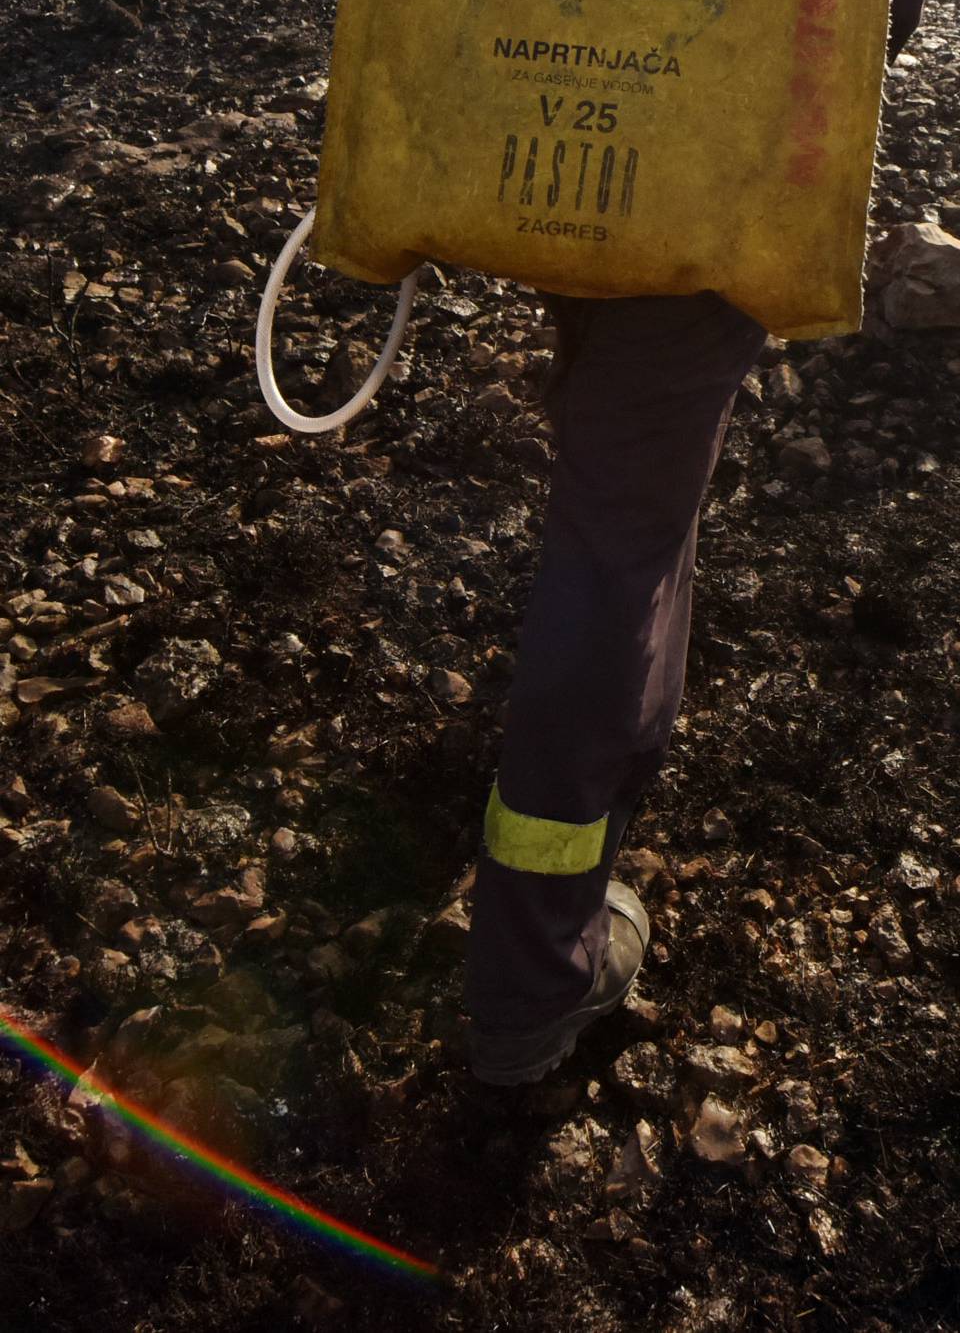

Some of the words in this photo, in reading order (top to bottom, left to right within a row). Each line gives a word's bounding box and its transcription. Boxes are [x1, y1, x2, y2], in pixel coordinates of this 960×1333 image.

[493, 37, 681, 77] NAPRTNJAČA
[511, 69, 530, 82] ZA
[602, 80, 654, 95] VODOM
[540, 95, 564, 126] V
[572, 100, 618, 133] 25
[498, 134, 640, 216] PASTOR
[516, 217, 608, 242] ZAGREB
